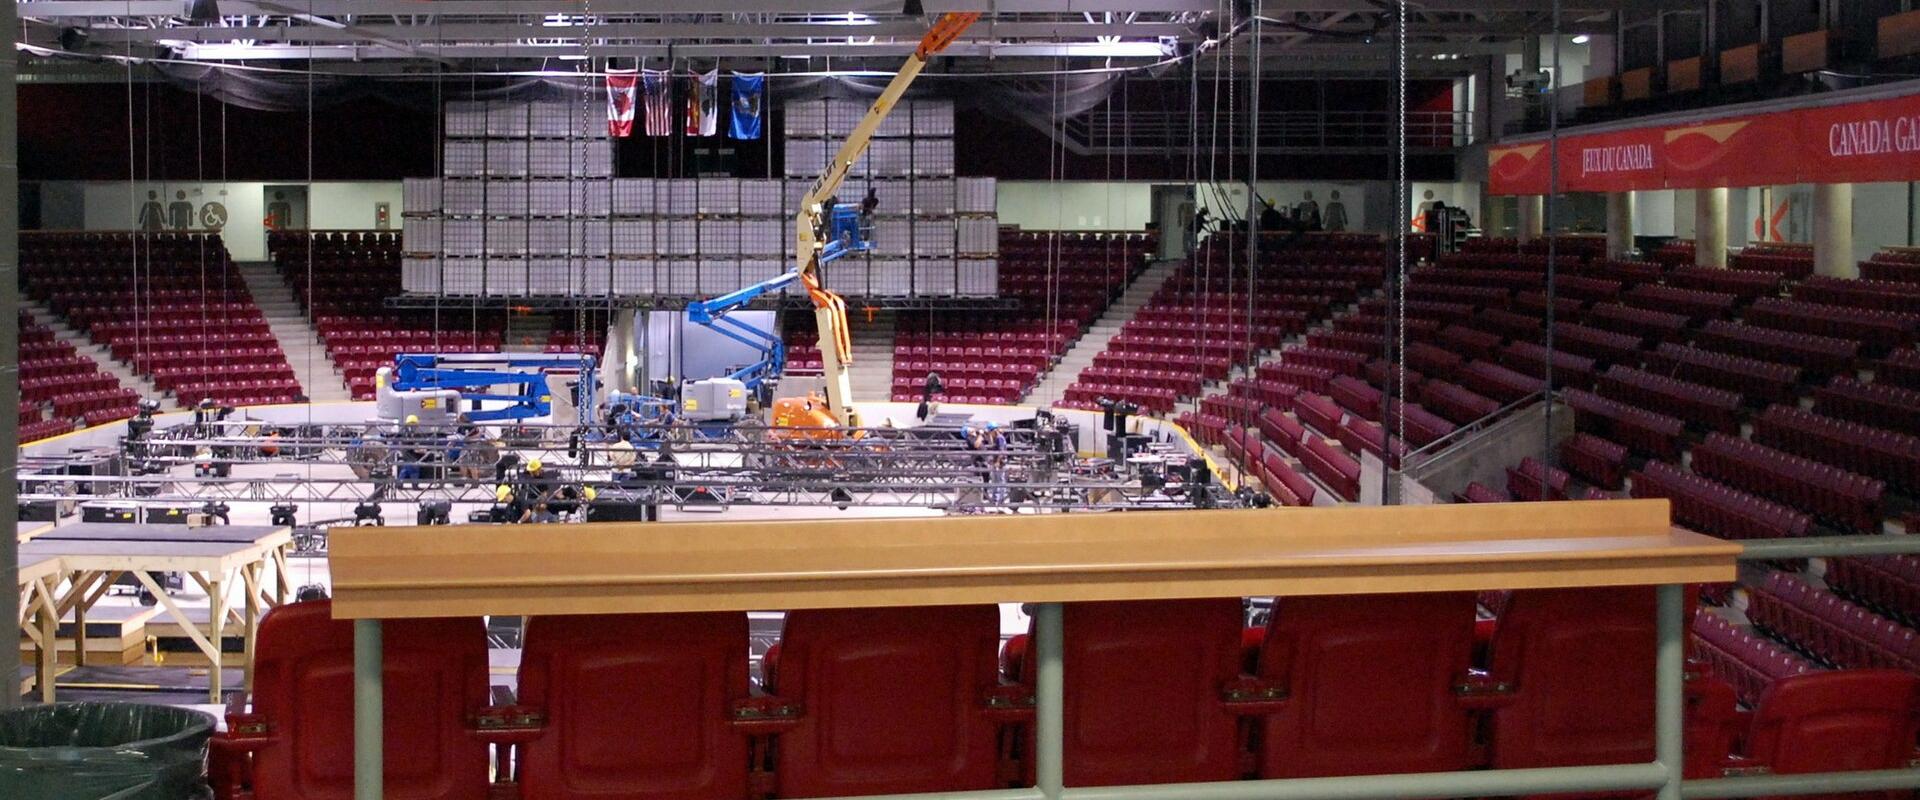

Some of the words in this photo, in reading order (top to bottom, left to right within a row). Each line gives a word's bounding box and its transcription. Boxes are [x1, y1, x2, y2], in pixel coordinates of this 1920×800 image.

[1829, 120, 1892, 156] CANADA
[1895, 116, 1920, 152] GA
[823, 160, 836, 181] LIFT
[1582, 148, 1601, 178] JEUX
[1602, 147, 1615, 172] DU
[1616, 144, 1652, 171] CANADA
